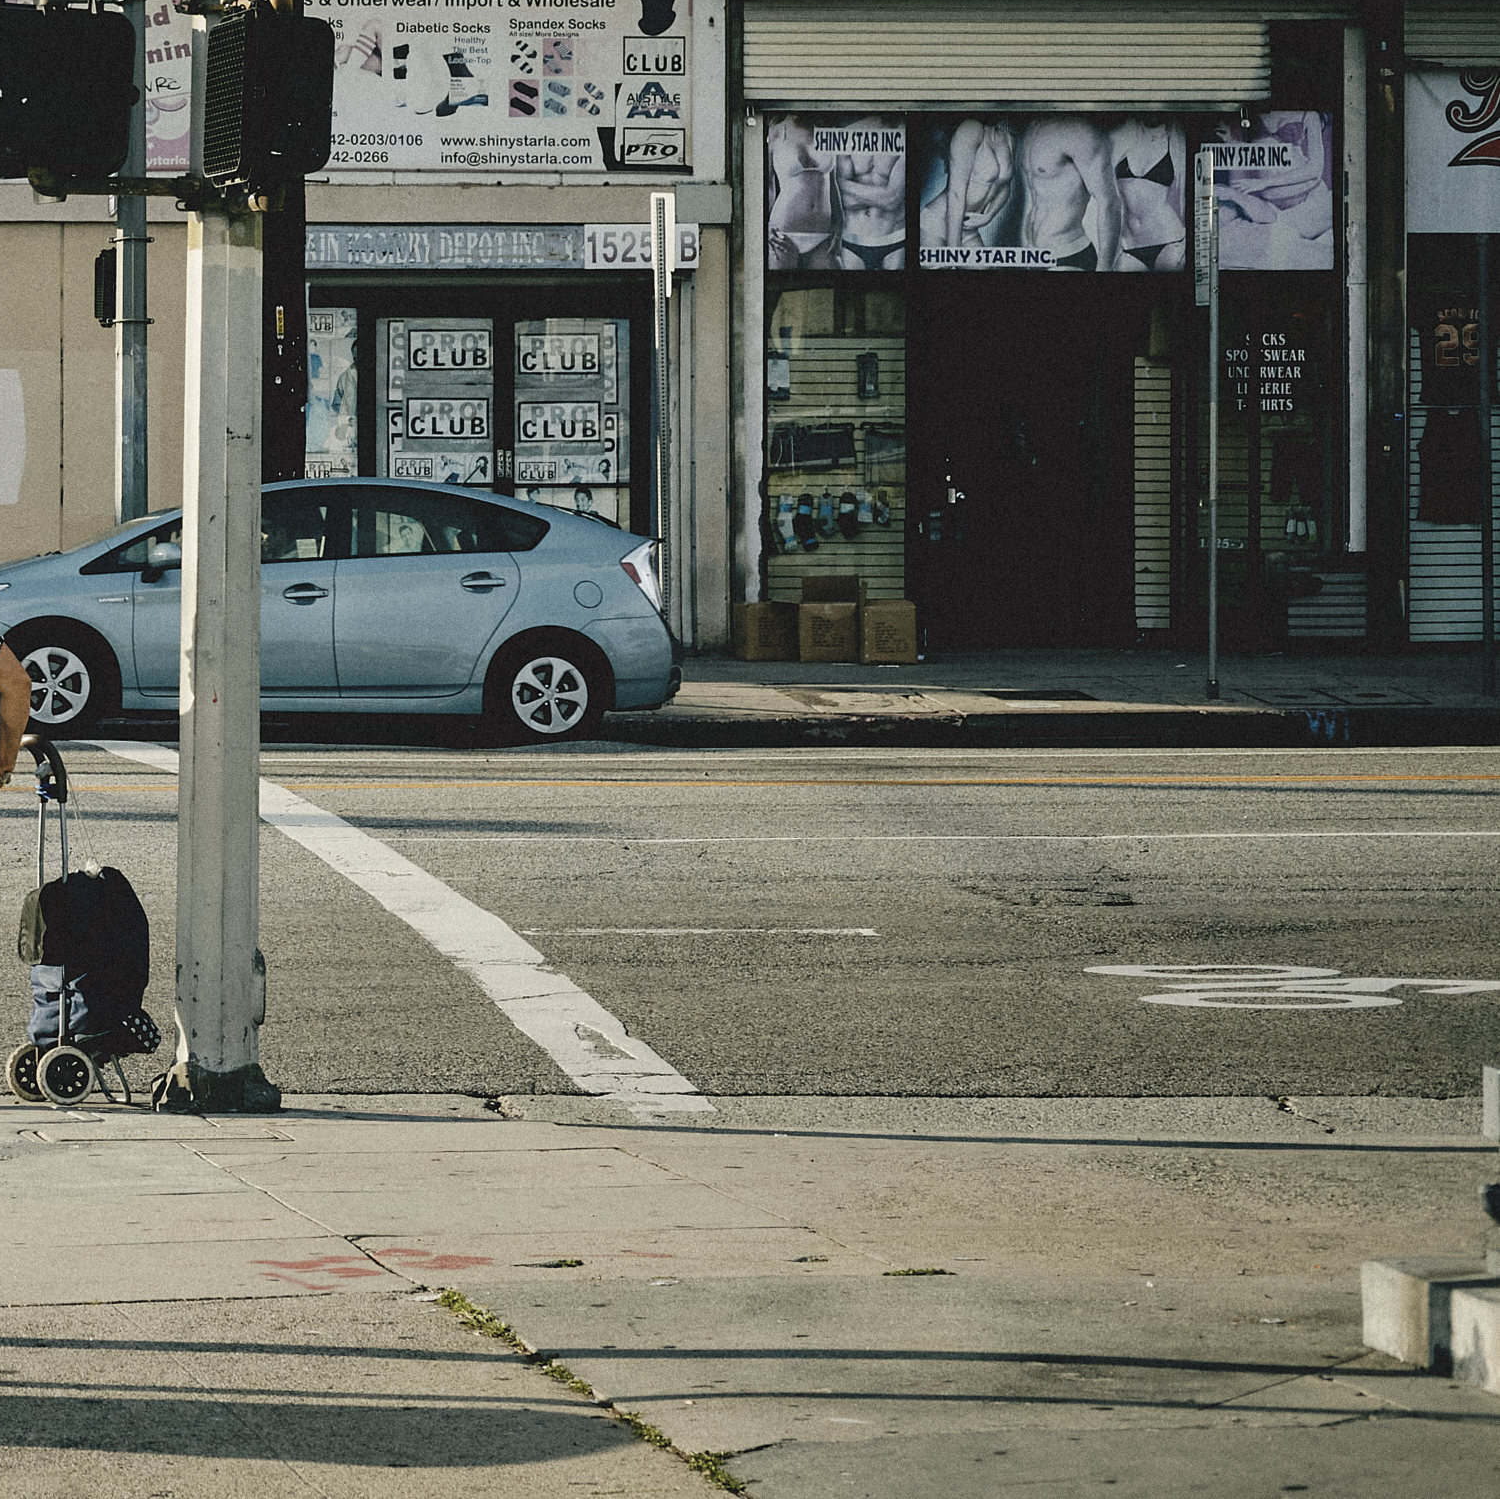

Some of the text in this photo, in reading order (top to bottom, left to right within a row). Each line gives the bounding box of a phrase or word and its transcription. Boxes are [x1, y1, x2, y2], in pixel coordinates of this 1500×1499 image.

[396, 22, 491, 34] Diabetic Socks
[508, 18, 606, 32] Spandex Socks
[453, 36, 487, 46] Healthy
[469, 46, 489, 55] Best
[626, 53, 683, 72] CLUB
[440, 134, 592, 150] www.shinystarla.com
[814, 131, 905, 152] SHINY STAR INC.
[625, 143, 679, 157] PRO
[1238, 145, 1266, 168] STAR
[1267, 145, 1292, 168] INC.
[440, 151, 593, 167] info@shinystarla.com
[438, 232, 506, 264] DEPOT
[586, 230, 652, 264] 1525
[679, 230, 699, 263] B
[919, 249, 1057, 265] SHINY STAR INC.
[421, 332, 588, 356] PRO PRO
[412, 348, 488, 367] CLUB
[521, 351, 597, 371] CLUB
[419, 401, 588, 424] PRO PRO
[410, 416, 598, 439] CLUB CLUB
[400, 459, 426, 469] PRO
[396, 466, 432, 476] CLUB
[520, 469, 555, 480] CLUB
